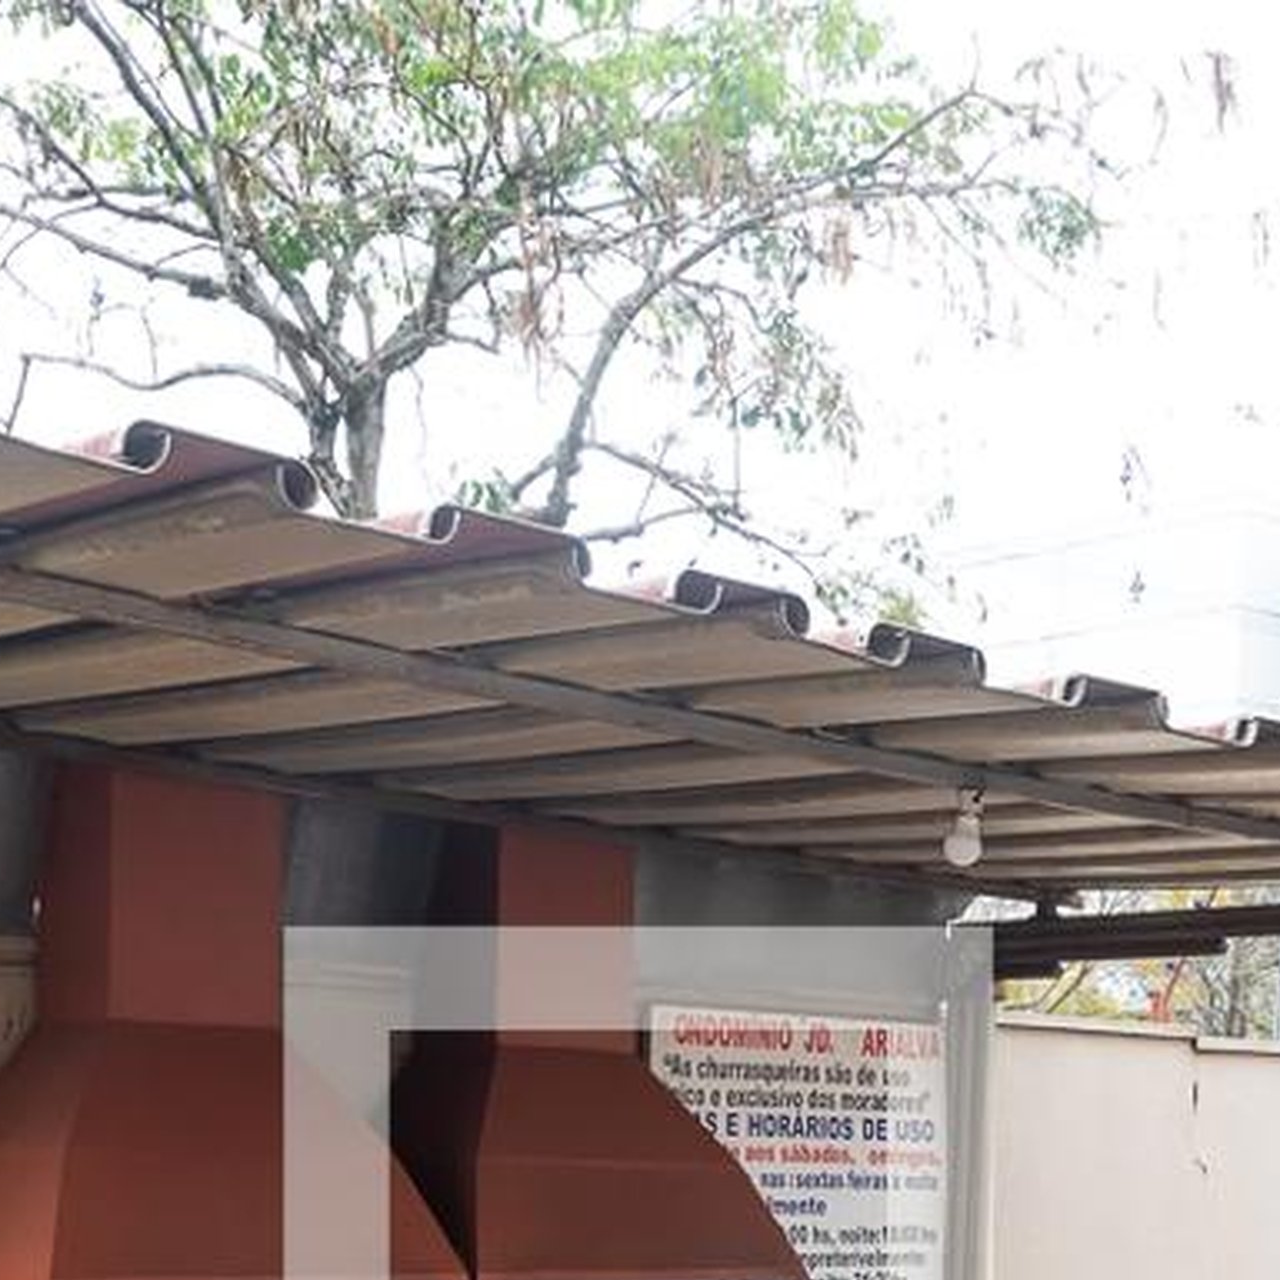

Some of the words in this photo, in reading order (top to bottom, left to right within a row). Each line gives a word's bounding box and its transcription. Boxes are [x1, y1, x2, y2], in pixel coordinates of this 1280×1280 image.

[696, 1055, 821, 1087] churrasqueiras
[857, 1062, 877, 1086] de
[726, 1085, 804, 1109] exclusivo
[808, 1089, 835, 1110] dos
[726, 1113, 739, 1136] E
[748, 1110, 854, 1141] HORÁRIOS
[863, 1118, 887, 1141] DE
[895, 1120, 936, 1143] USO
